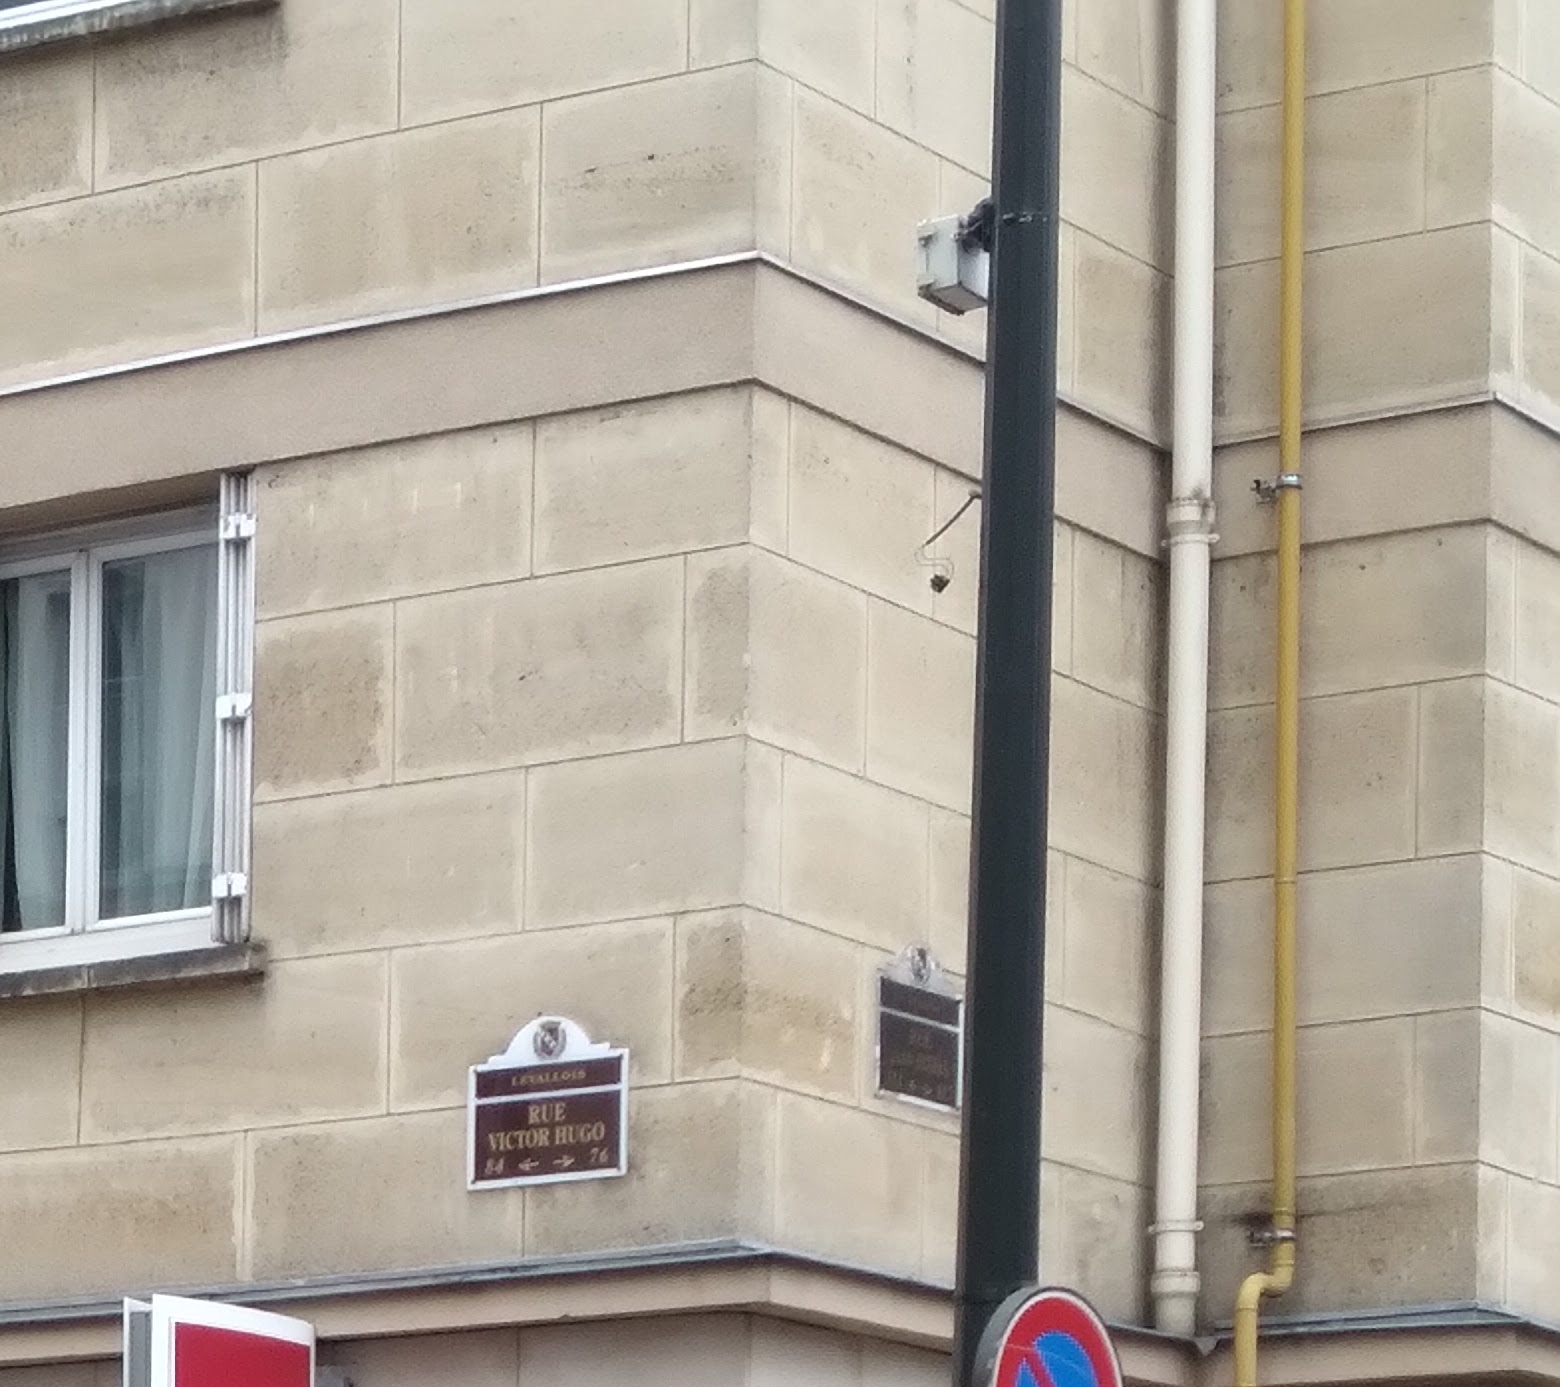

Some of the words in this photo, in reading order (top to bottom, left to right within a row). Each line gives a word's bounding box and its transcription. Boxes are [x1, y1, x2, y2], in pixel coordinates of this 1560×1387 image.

[511, 1069, 587, 1087] LEVALLOIS
[527, 1102, 566, 1125] RUE
[489, 1127, 550, 1151] VICTOR
[555, 1121, 605, 1145] HUGO
[590, 1147, 609, 1164] 76
